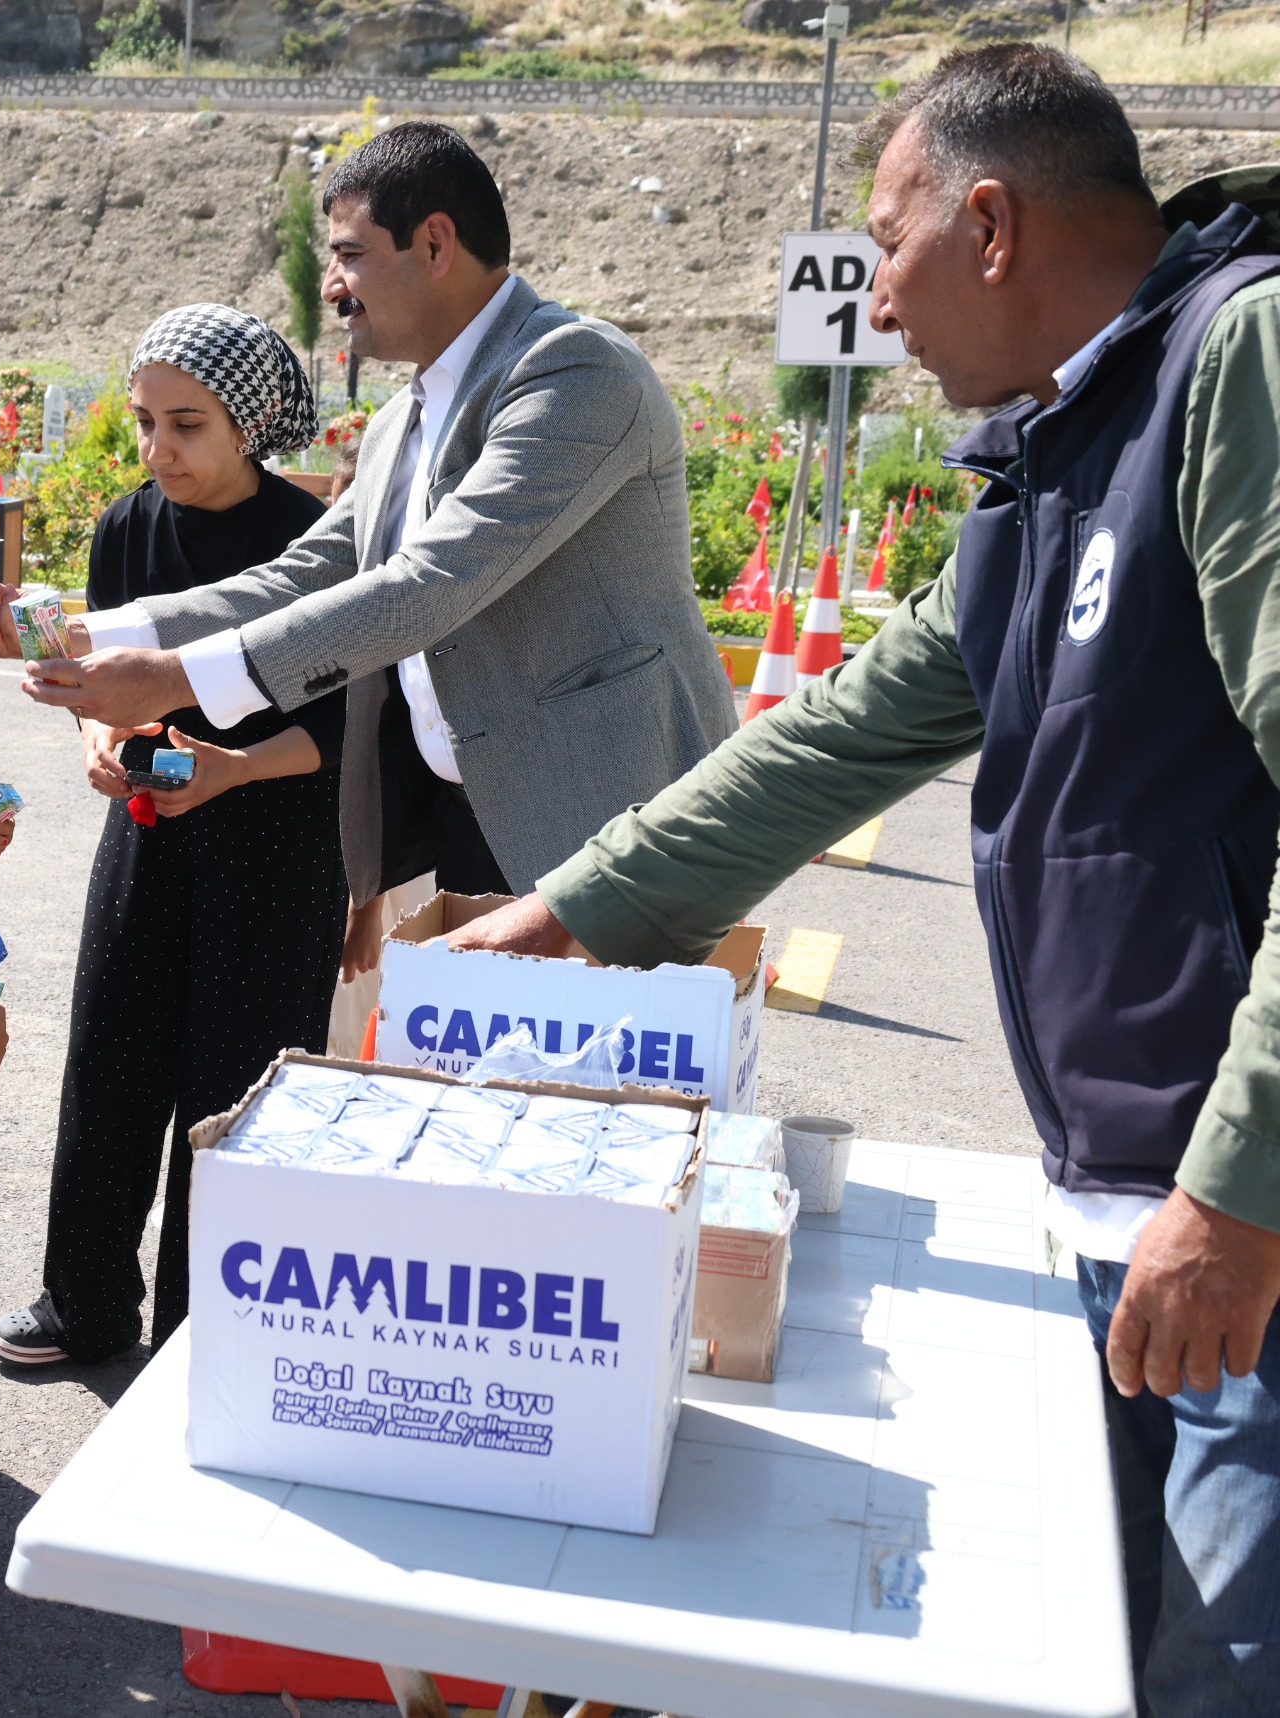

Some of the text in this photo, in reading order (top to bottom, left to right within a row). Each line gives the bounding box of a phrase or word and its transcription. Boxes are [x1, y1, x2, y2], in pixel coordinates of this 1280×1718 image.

[826, 301, 858, 355] 1
[261, 1310, 619, 1369] NURAL KAYNAK SULARI
[273, 1388, 333, 1412] Natural
[335, 1397, 387, 1420] Spring
[391, 1403, 439, 1425] Water
[455, 1411, 553, 1438] Quellwasser
[274, 1357, 554, 1417] Doğal Kaynak Suyu
[272, 1405, 301, 1424] Eau
[302, 1408, 322, 1427] de
[322, 1412, 373, 1433] Source
[384, 1420, 463, 1445] Bronwater
[474, 1430, 553, 1456] Kildevand
